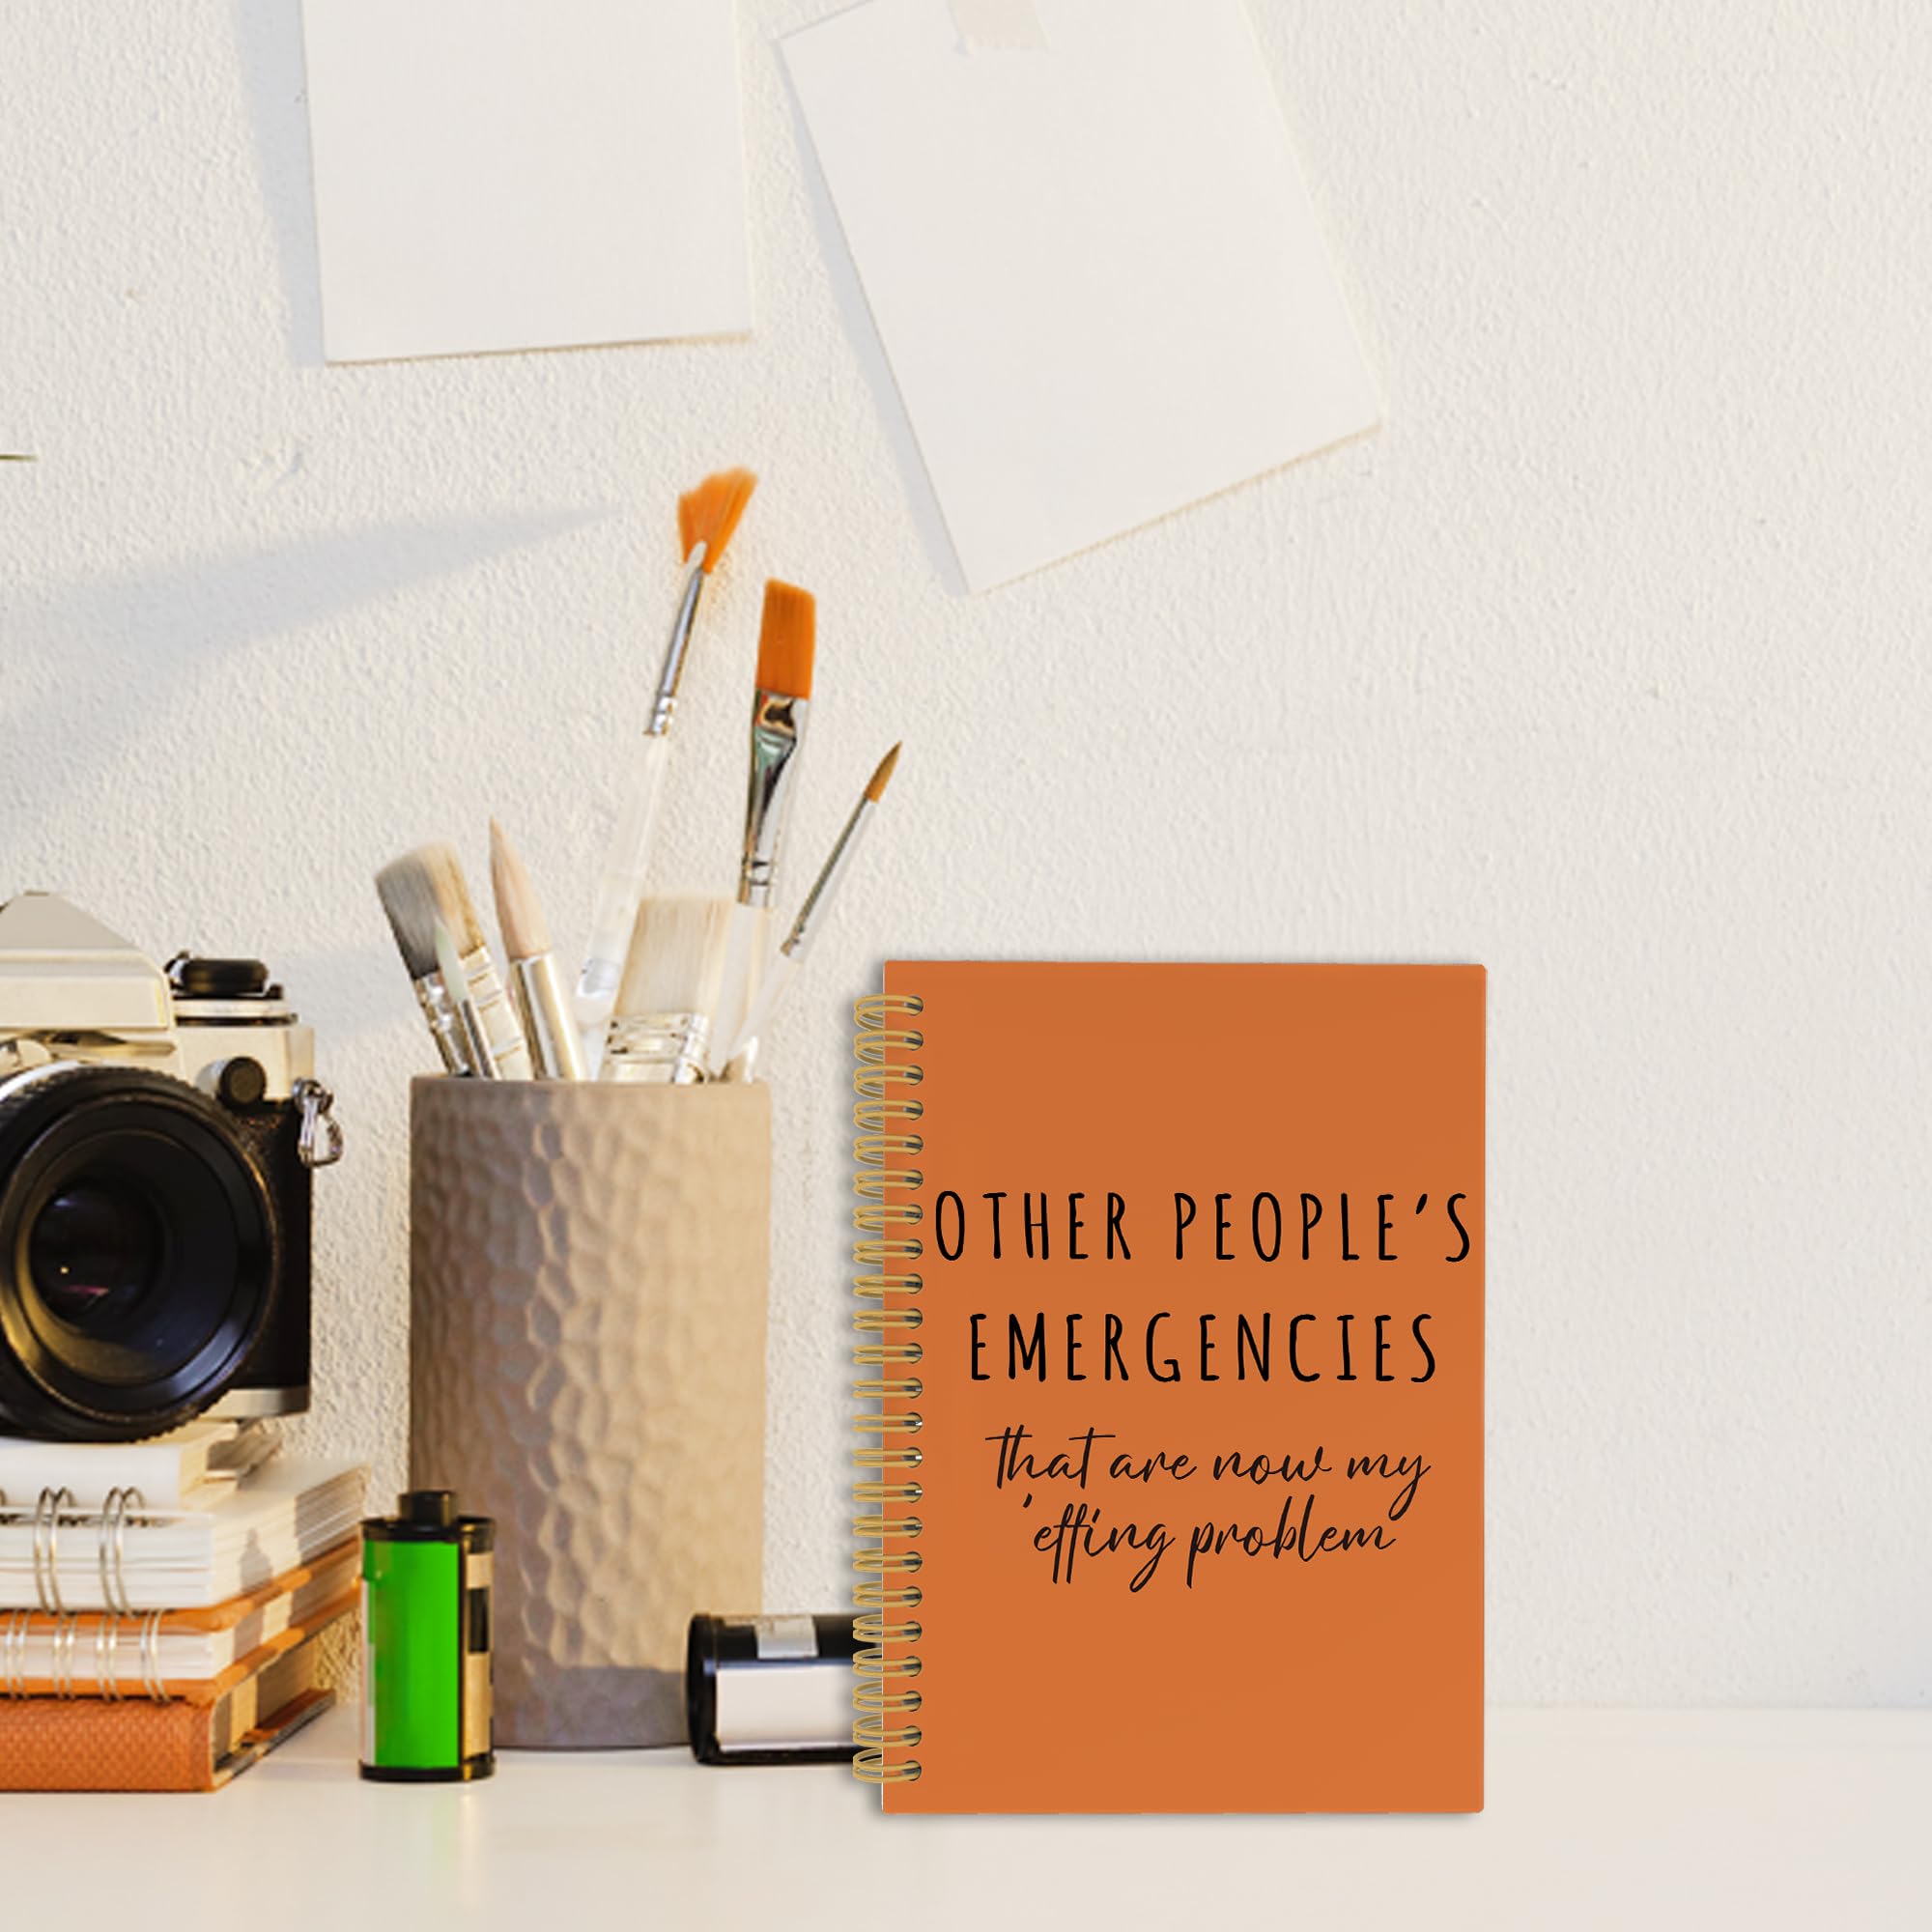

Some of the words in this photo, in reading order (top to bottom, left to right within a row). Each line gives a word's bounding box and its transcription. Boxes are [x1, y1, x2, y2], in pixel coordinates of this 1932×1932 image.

[935, 1190, 1131, 1262] OTHER
[1174, 1191, 1471, 1263] PEOPLE'S
[969, 1312, 1436, 1383] EMERGENCIES
[984, 1424, 1116, 1490] that
[1109, 1451, 1198, 1483] are
[1212, 1445, 1333, 1486] now
[1347, 1453, 1432, 1521] my
[1022, 1492, 1176, 1593] 'effing
[1186, 1493, 1397, 1589] problem
